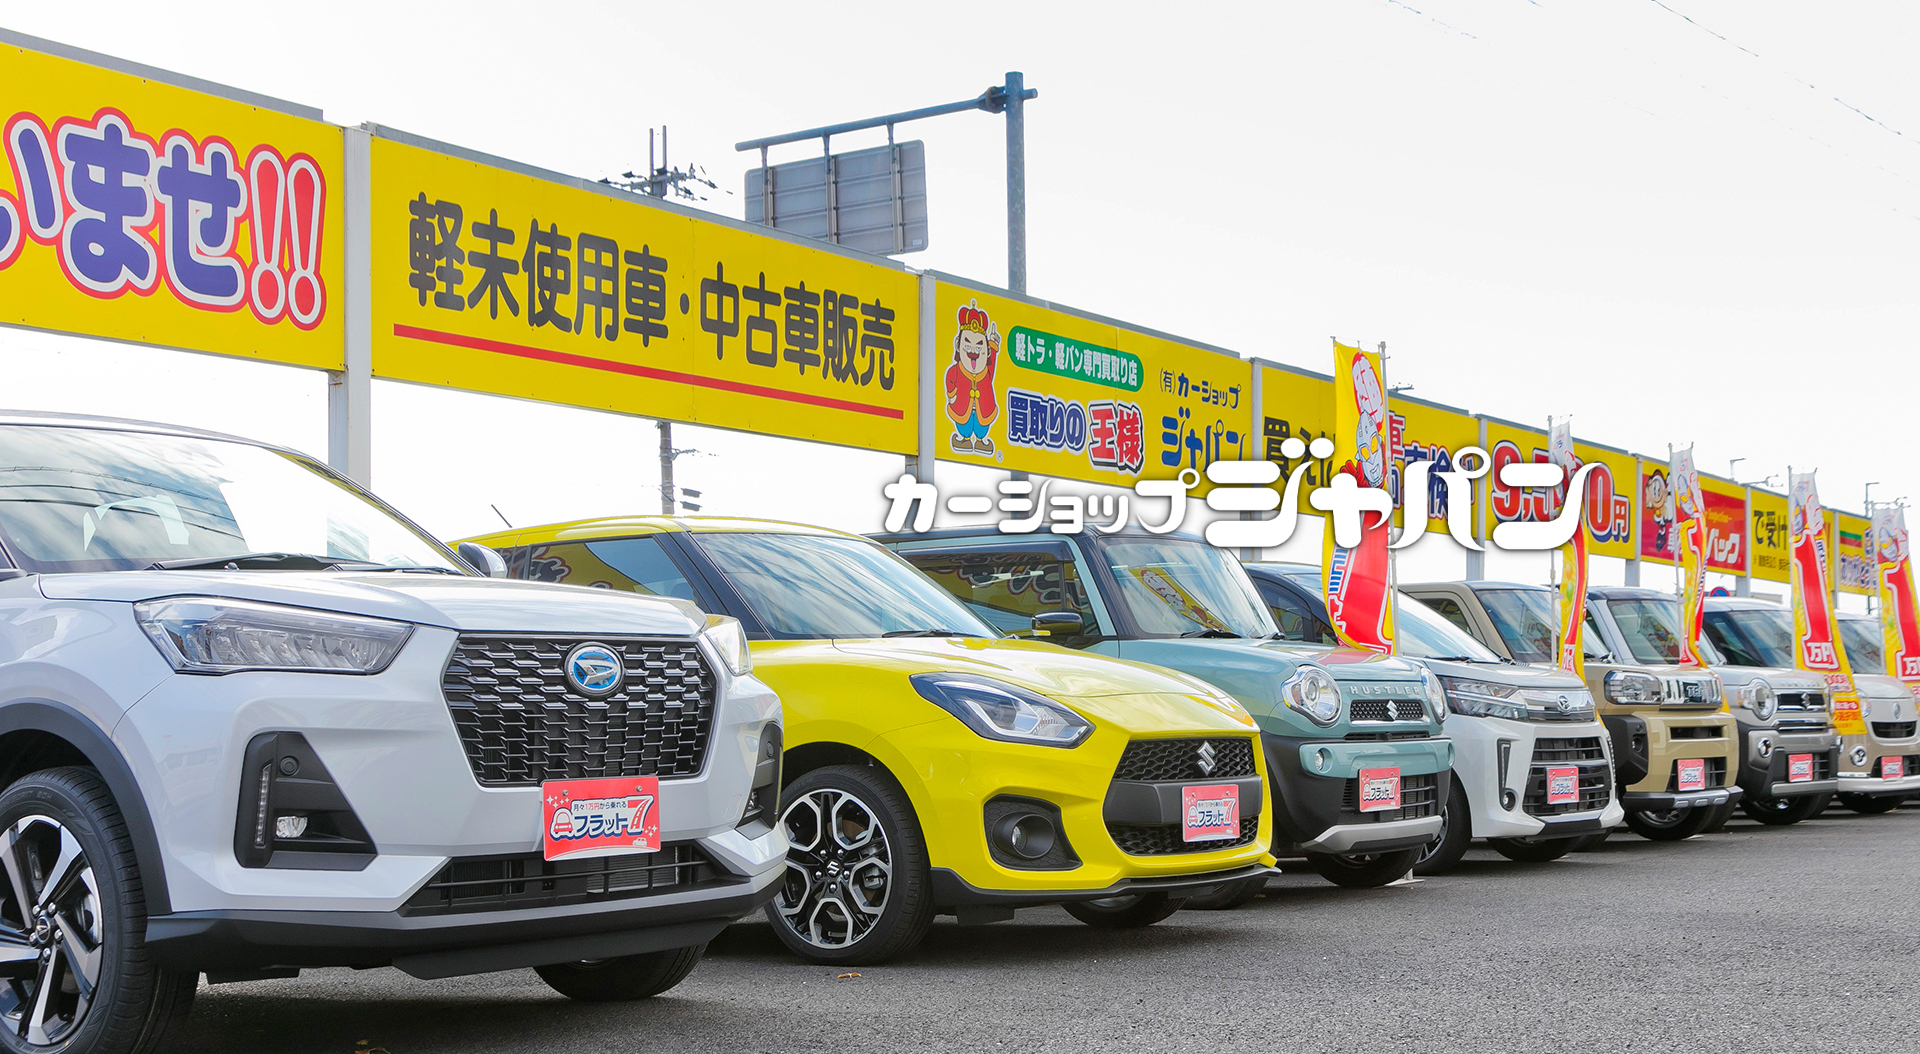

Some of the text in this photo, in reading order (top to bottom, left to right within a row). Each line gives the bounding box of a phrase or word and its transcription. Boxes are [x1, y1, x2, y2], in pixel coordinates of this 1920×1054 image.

[409, 191, 895, 391] 軽未使用車・中古車販売
[1349, 685, 1421, 695] HUSTLER
